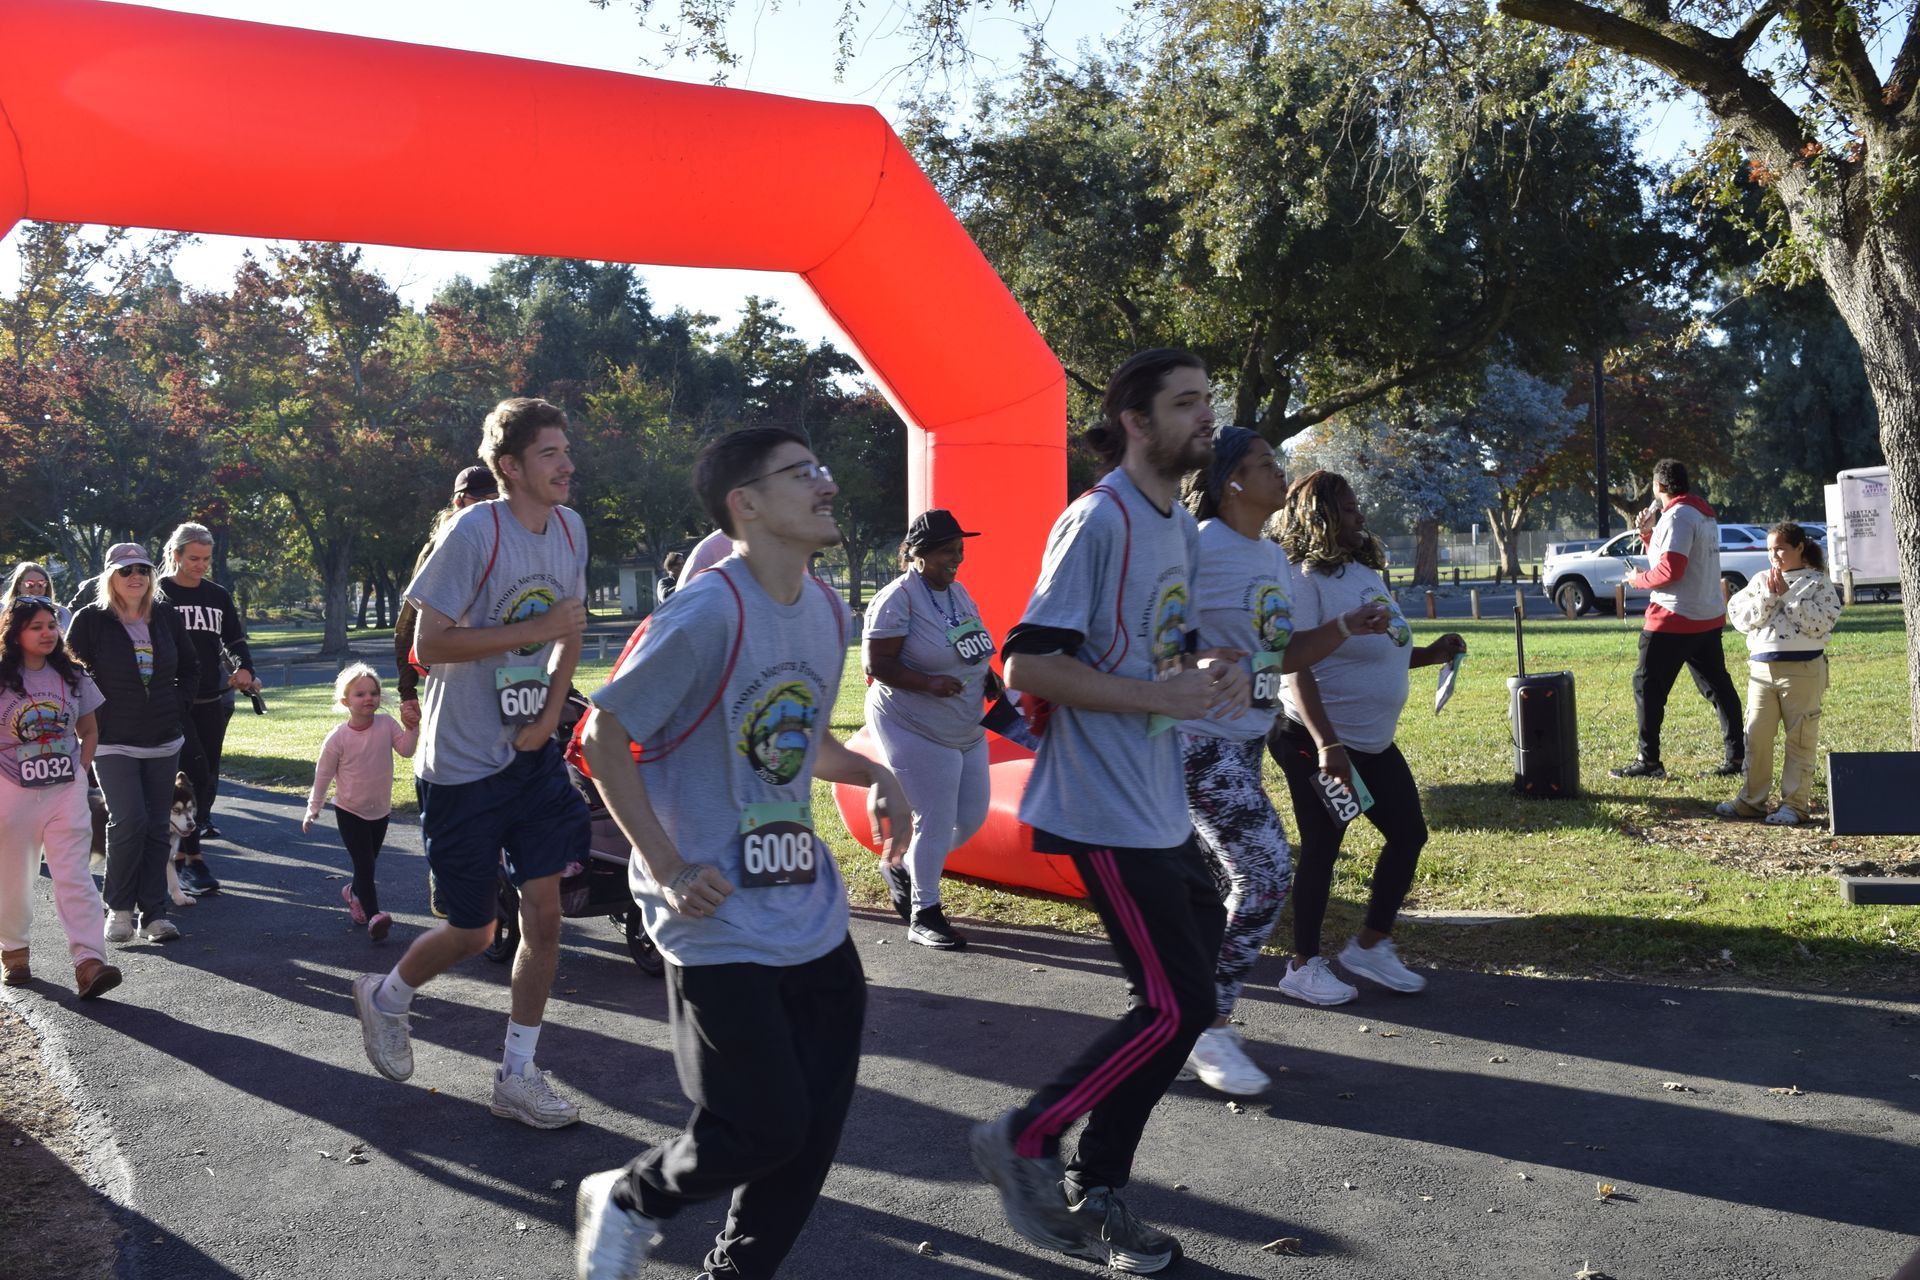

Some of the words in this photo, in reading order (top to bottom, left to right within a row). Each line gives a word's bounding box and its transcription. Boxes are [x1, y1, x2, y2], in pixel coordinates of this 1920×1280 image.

[488, 584, 519, 622] Lamont
[956, 632, 993, 659] 6016
[21, 756, 73, 781] 6032
[744, 831, 815, 875] 6008
